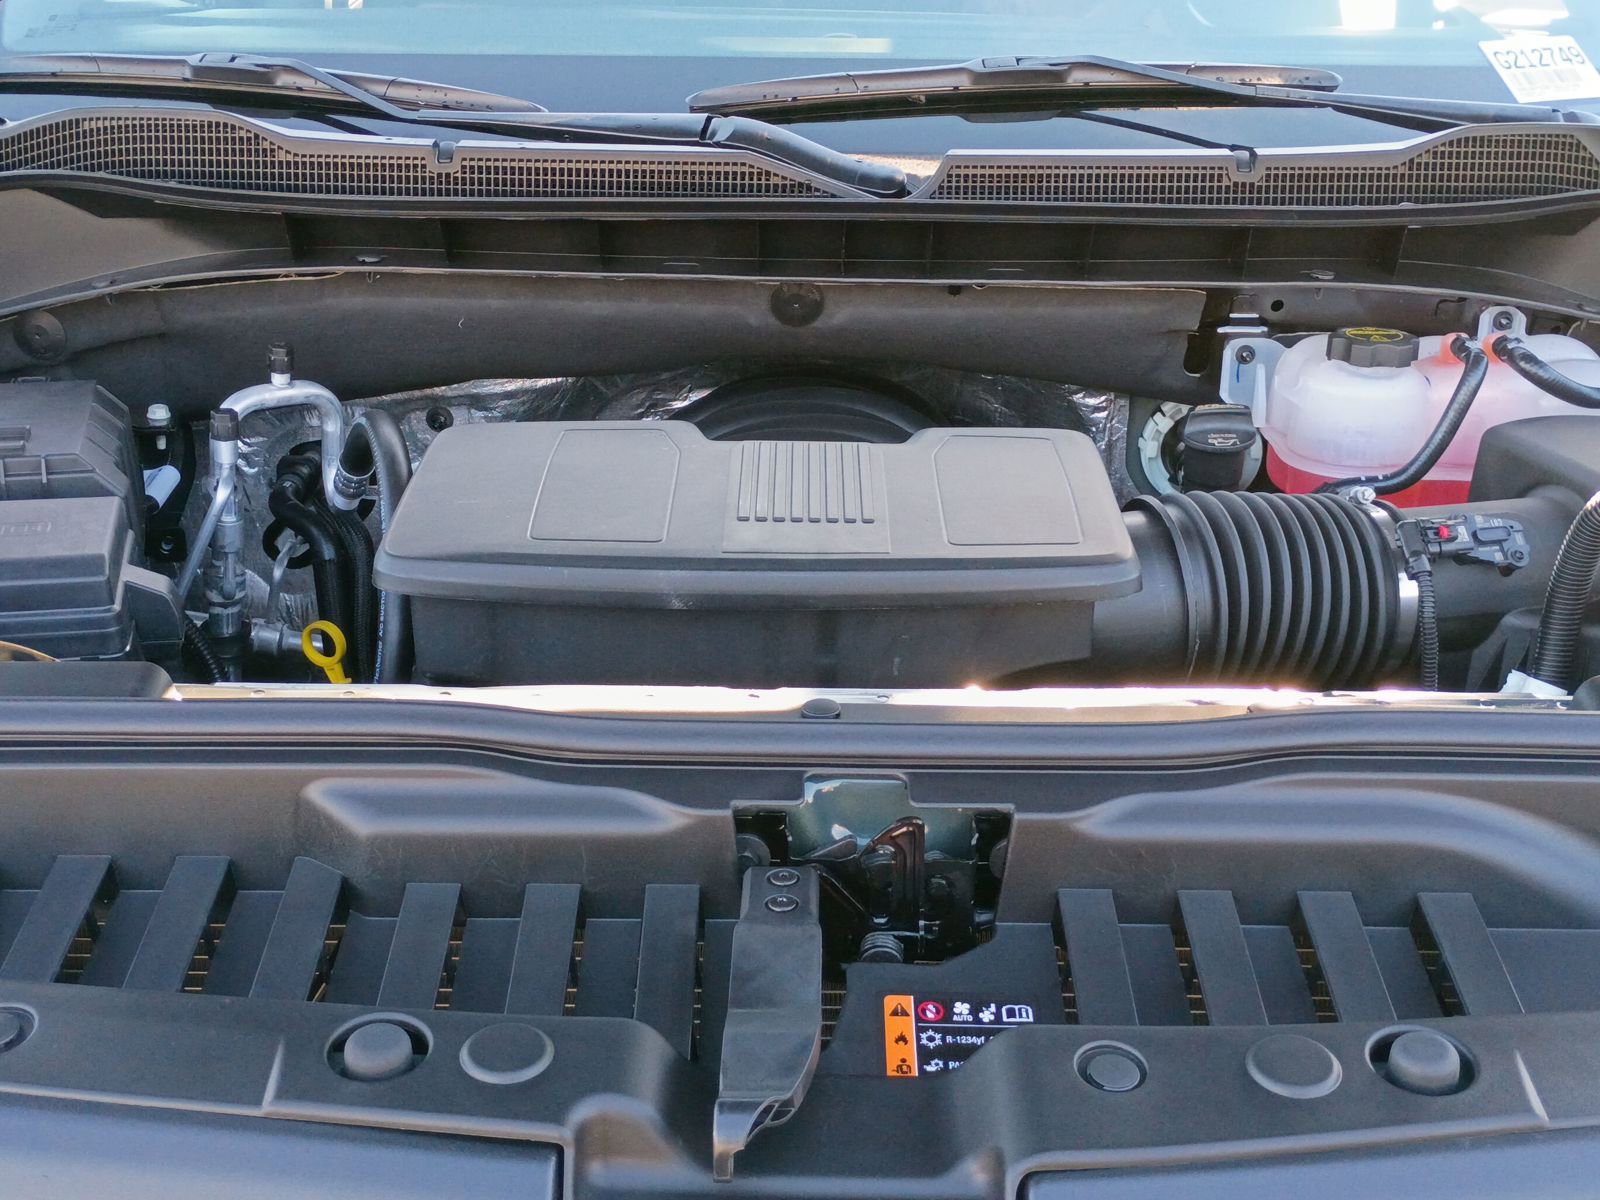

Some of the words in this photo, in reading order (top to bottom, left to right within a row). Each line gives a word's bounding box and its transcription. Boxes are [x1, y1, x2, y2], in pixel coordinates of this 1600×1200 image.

[1493, 46, 1585, 69] G212749
[952, 1014, 974, 1022] AUTO
[945, 1035, 985, 1046] R-1234yf
